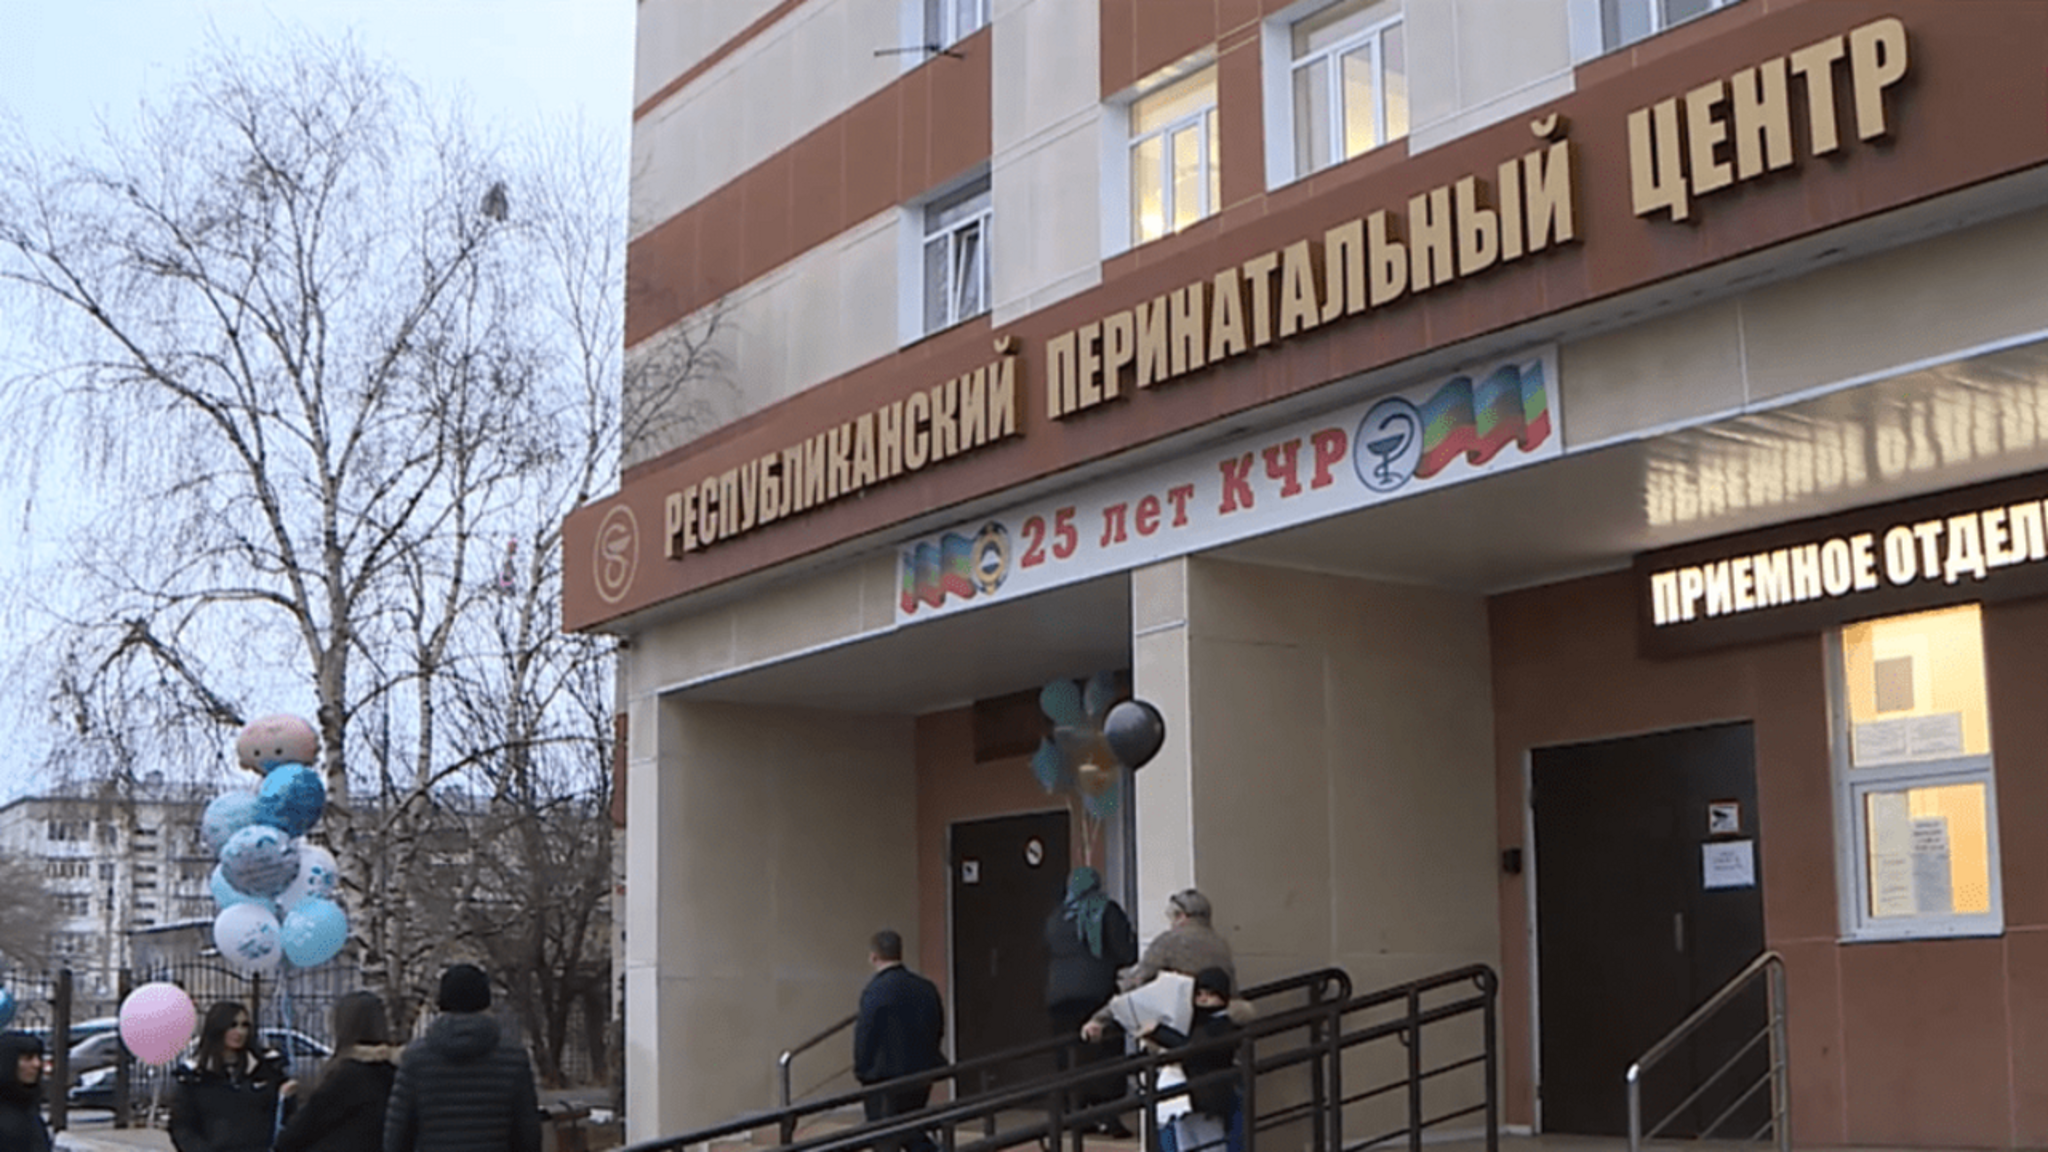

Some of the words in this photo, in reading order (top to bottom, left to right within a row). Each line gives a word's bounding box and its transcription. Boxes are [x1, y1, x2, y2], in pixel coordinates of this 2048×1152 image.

[664, 336, 1017, 561] РЕСПУБЛИКАНСКИЙ
[1047, 113, 1574, 420] ПЕРИНАТАЛЬНЫЙ
[1628, 17, 1908, 221] ЦЕНТР
[1021, 506, 1078, 569] 25
[1100, 484, 1194, 547] лет
[1219, 427, 1347, 515] КЧР
[1651, 533, 1877, 626] ПРИЕМНОЕ
[1884, 500, 2048, 584] ОТДЕЛ
